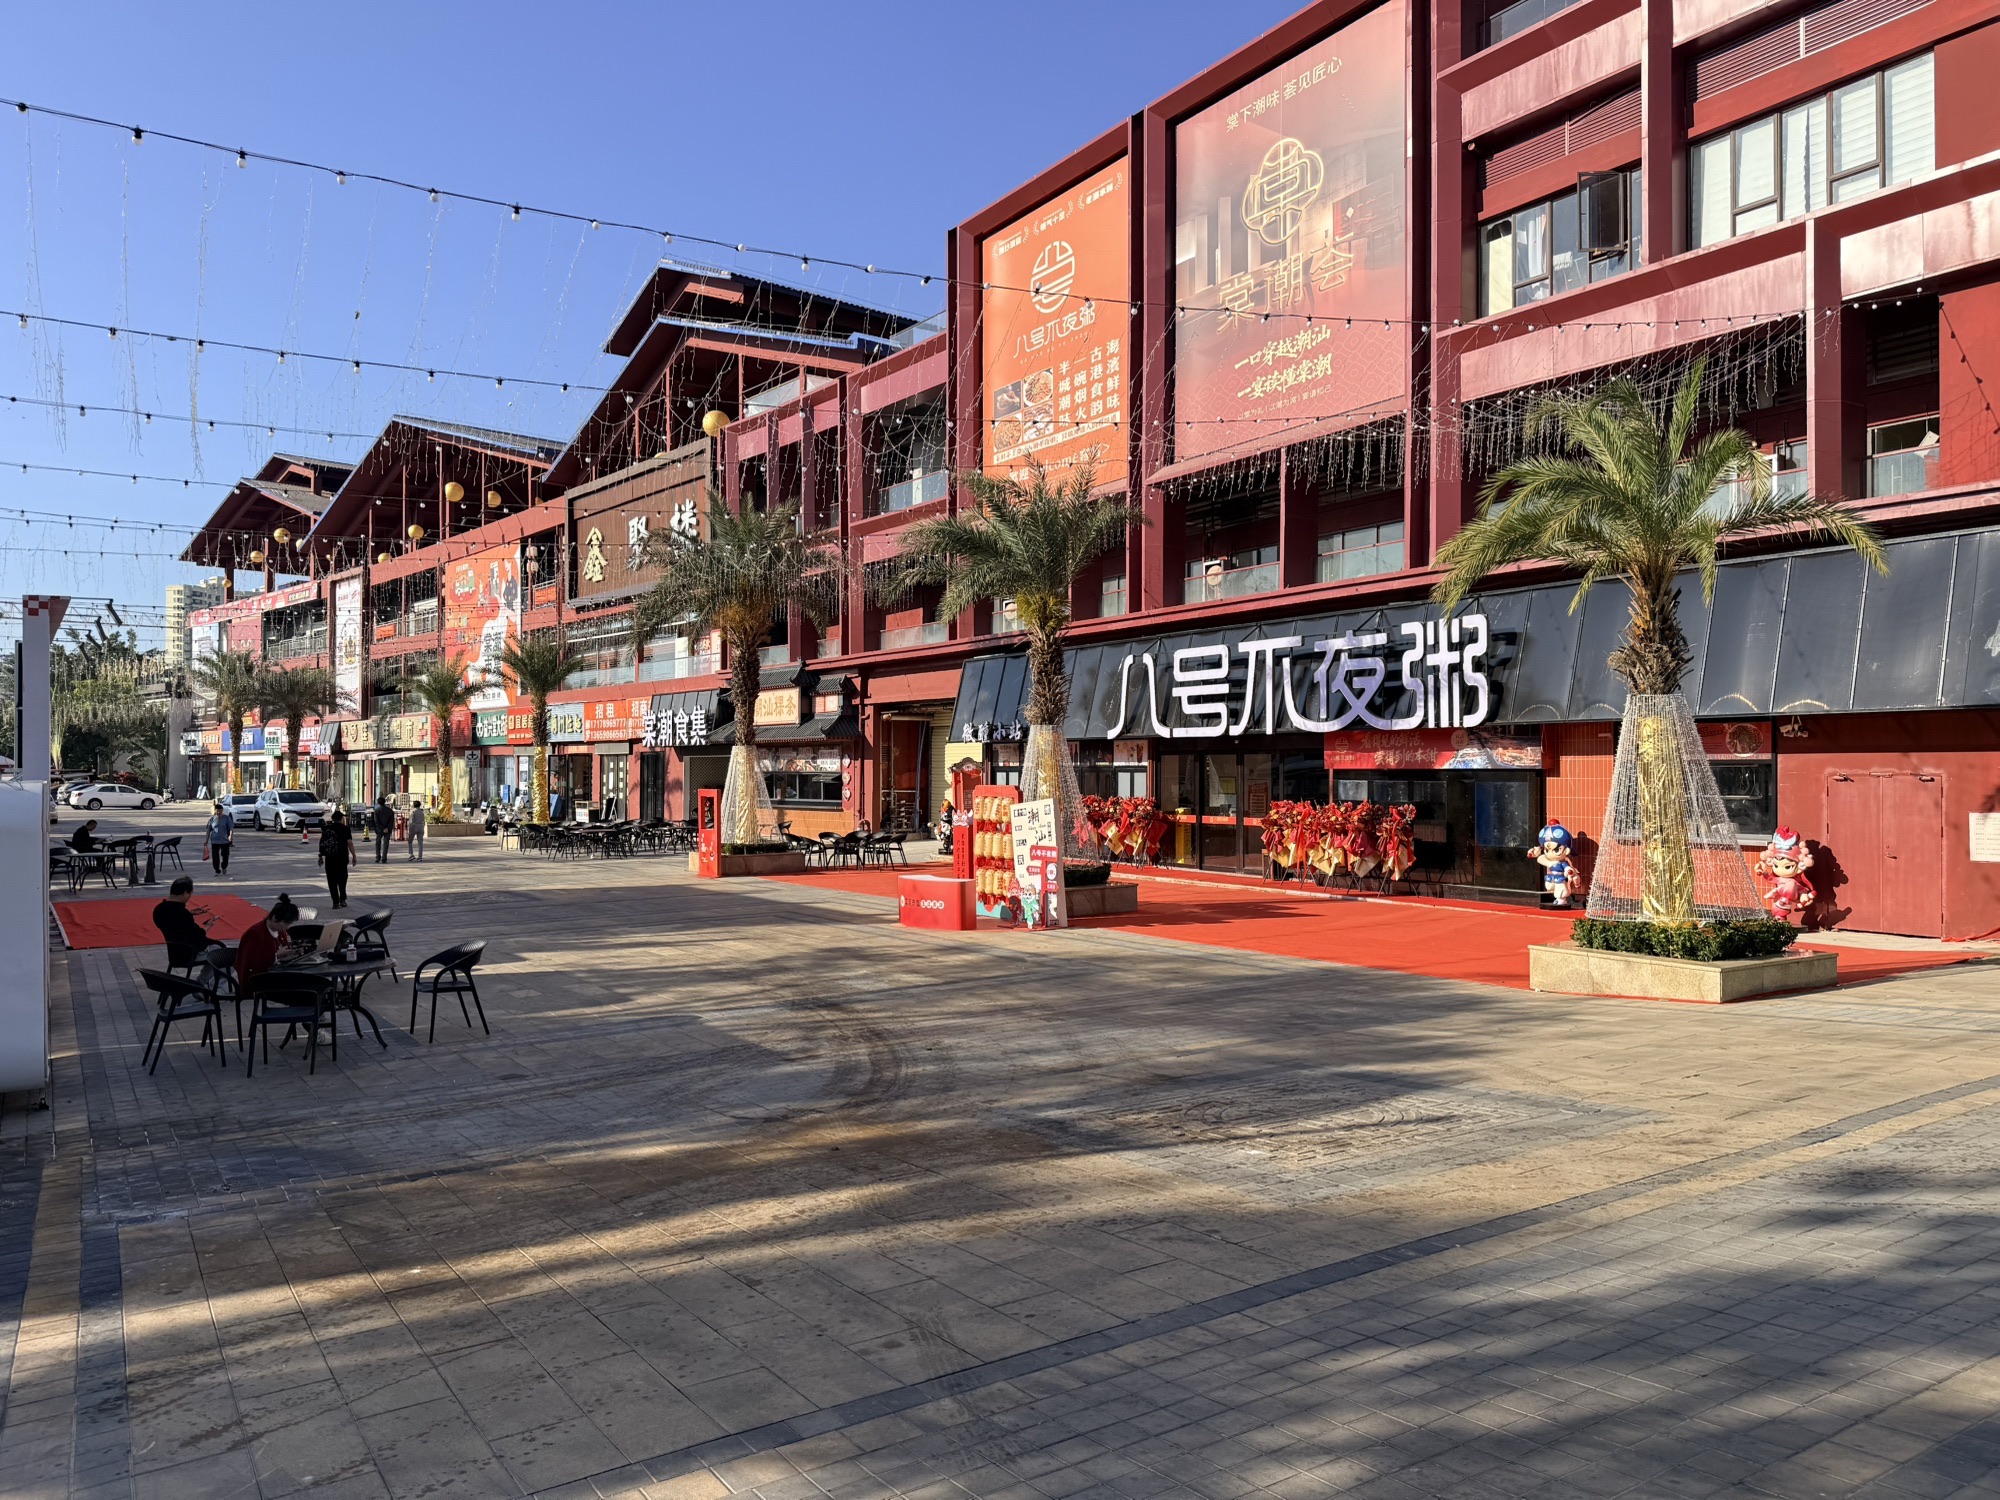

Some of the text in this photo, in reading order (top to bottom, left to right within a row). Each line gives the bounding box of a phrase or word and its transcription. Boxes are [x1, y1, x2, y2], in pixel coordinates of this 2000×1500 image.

[1226, 56, 1343, 132] 棠下潮味 荟见匠心
[1234, 323, 1331, 371] 一口穿越潮汕
[1106, 613, 1490, 740] 八号不夜粥
[595, 702, 615, 719] 招租
[631, 699, 652, 718] 招商
[642, 704, 707, 748] 棠潮食集
